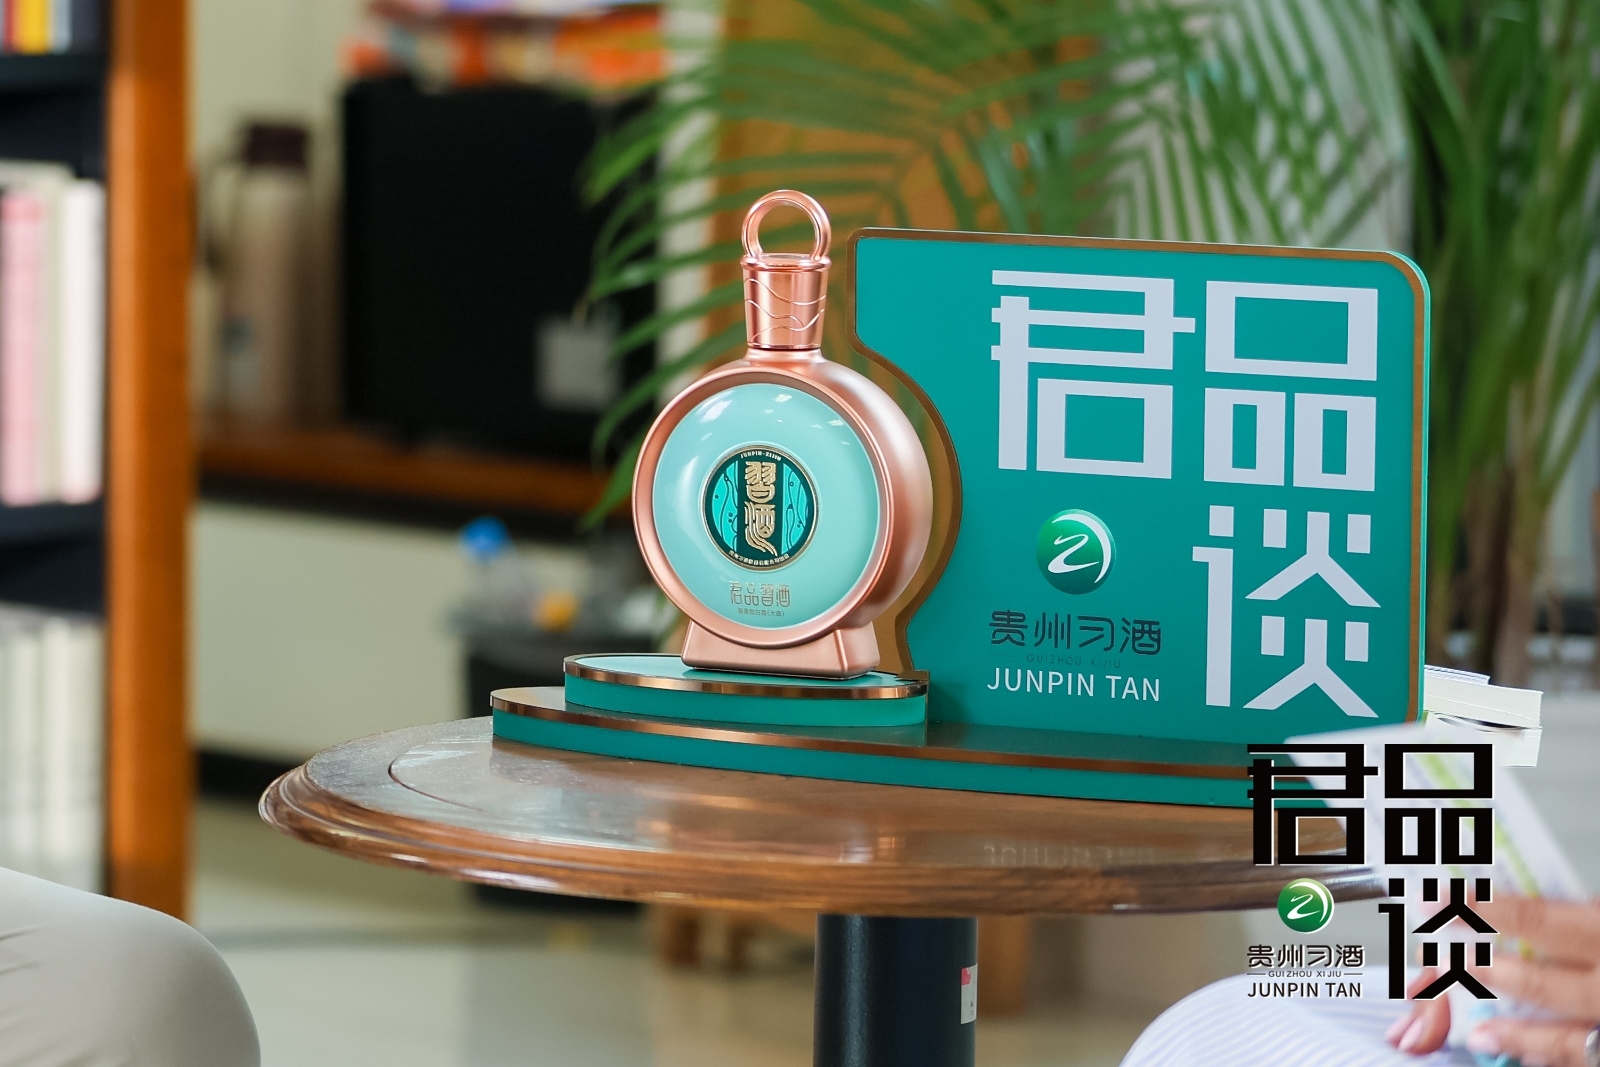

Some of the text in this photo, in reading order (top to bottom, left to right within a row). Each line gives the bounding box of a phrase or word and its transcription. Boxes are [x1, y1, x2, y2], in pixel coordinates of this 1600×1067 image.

[1192, 505, 1381, 717] 谈
[989, 610, 1161, 655] 贵州习酒
[1026, 653, 1121, 668] GUIZHOU XIJIU
[987, 667, 1160, 702] JUNPIN TAN
